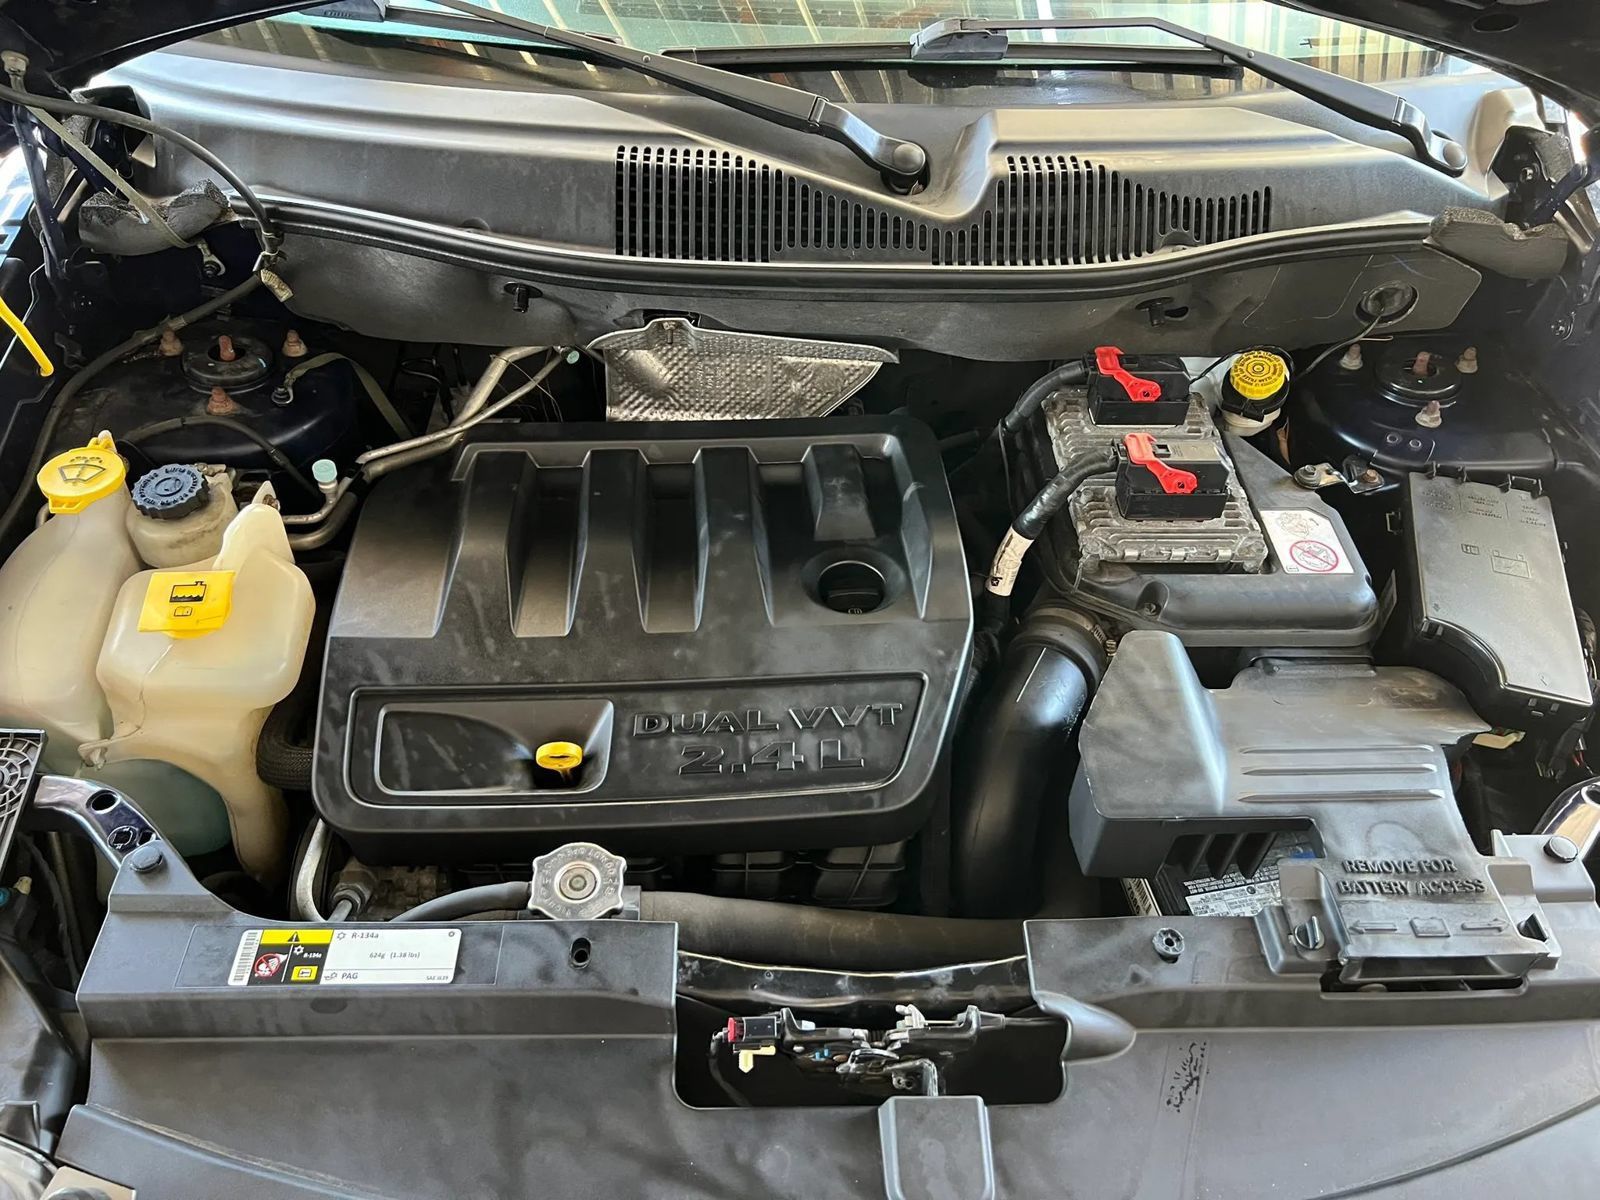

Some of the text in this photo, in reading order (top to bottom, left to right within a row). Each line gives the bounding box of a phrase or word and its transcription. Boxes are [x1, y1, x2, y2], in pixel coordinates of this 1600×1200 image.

[633, 703, 902, 737] DUAL VVT
[678, 739, 864, 775] 2.4L
[1342, 858, 1458, 874] REMOVE FOR
[1337, 878, 1487, 895] BATTERY ACCESS
[341, 972, 359, 980] PAG
